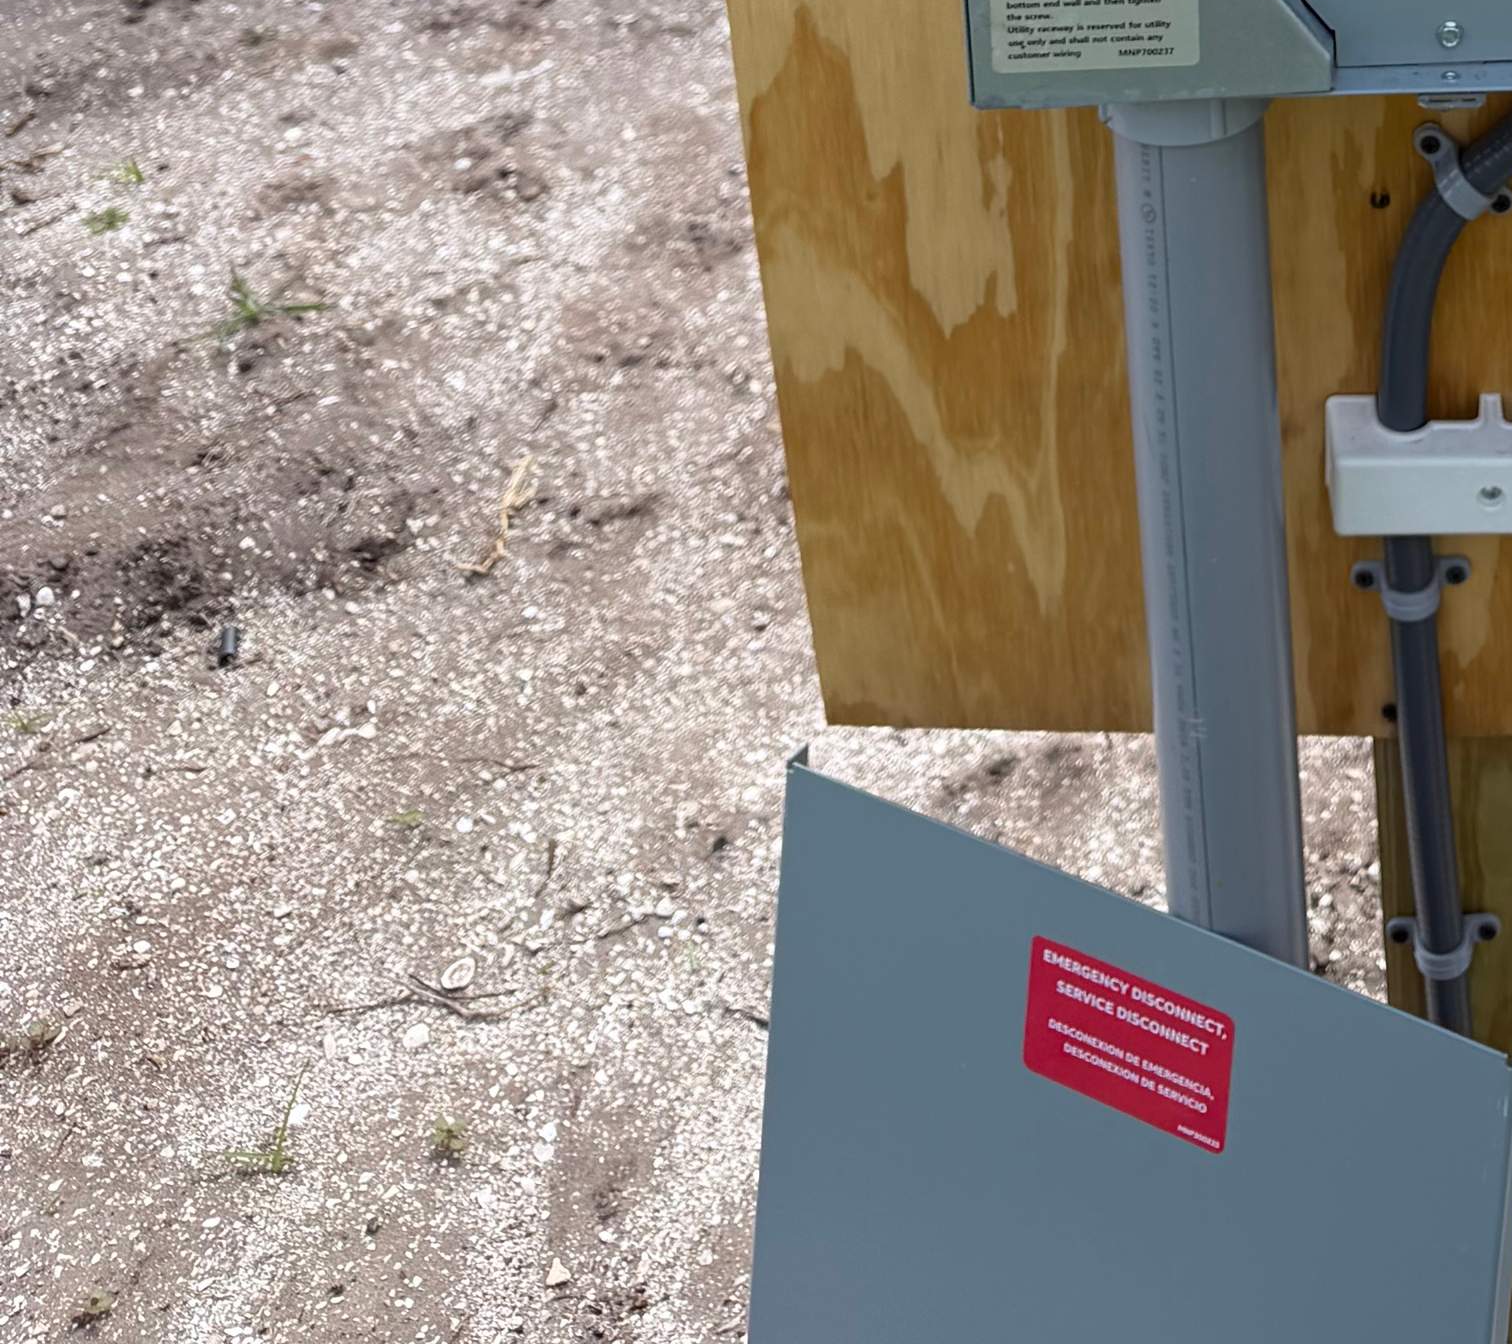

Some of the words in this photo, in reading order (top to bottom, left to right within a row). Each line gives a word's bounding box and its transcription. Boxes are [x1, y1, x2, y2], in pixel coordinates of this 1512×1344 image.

[1043, 0, 1060, 7] end
[1006, 13, 1021, 21] the
[1007, 25, 1034, 35] Utility
[1038, 25, 1074, 33] raceway
[1087, 22, 1126, 30] reserved
[1129, 21, 1141, 29] for
[1144, 19, 1171, 29] utility
[1027, 38, 1046, 47] only
[1049, 36, 1066, 44] and
[1110, 34, 1144, 42] contain
[1147, 34, 1163, 42] any
[1053, 50, 1082, 59] wiring
[1042, 948, 1129, 995] EMERGENCY
[1130, 985, 1228, 1040] DISCONNECT,
[1056, 980, 1115, 1015] SERVICE
[1116, 1005, 1209, 1056] DISCONNECT
[1125, 1051, 1140, 1066] DE
[1140, 1076, 1156, 1091] DE
[1157, 1084, 1208, 1114] SERVICIO
